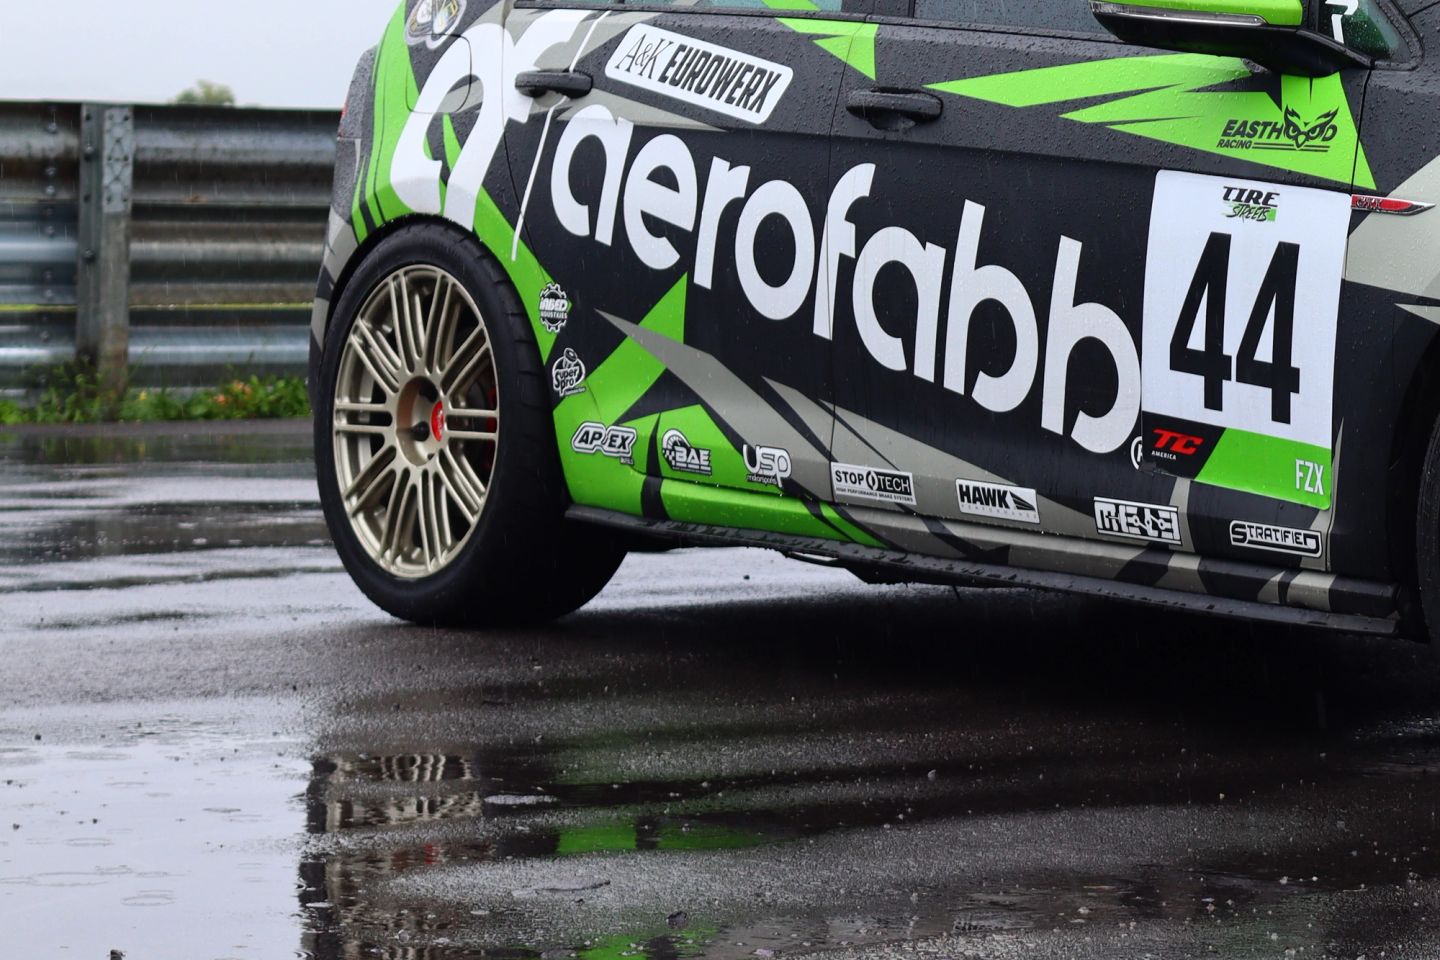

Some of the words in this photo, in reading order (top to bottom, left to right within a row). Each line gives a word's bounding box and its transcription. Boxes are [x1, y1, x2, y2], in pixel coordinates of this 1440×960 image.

[614, 33, 674, 80] A&K
[657, 44, 782, 114] EUROWERX
[1216, 138, 1253, 149] RACING
[1222, 185, 1280, 208] TIRE
[1226, 203, 1272, 222] STREETS
[550, 102, 1142, 454] aerofabb
[1169, 230, 1300, 426] 44
[577, 427, 633, 452] APEX
[1153, 428, 1205, 456] TC
[674, 445, 712, 468] BAE
[742, 443, 793, 488] USP
[1151, 450, 1177, 461] AMERICA
[1295, 458, 1325, 496] FZX
[958, 483, 1011, 510] HAWK
[1231, 523, 1323, 559] STRATIFIED
